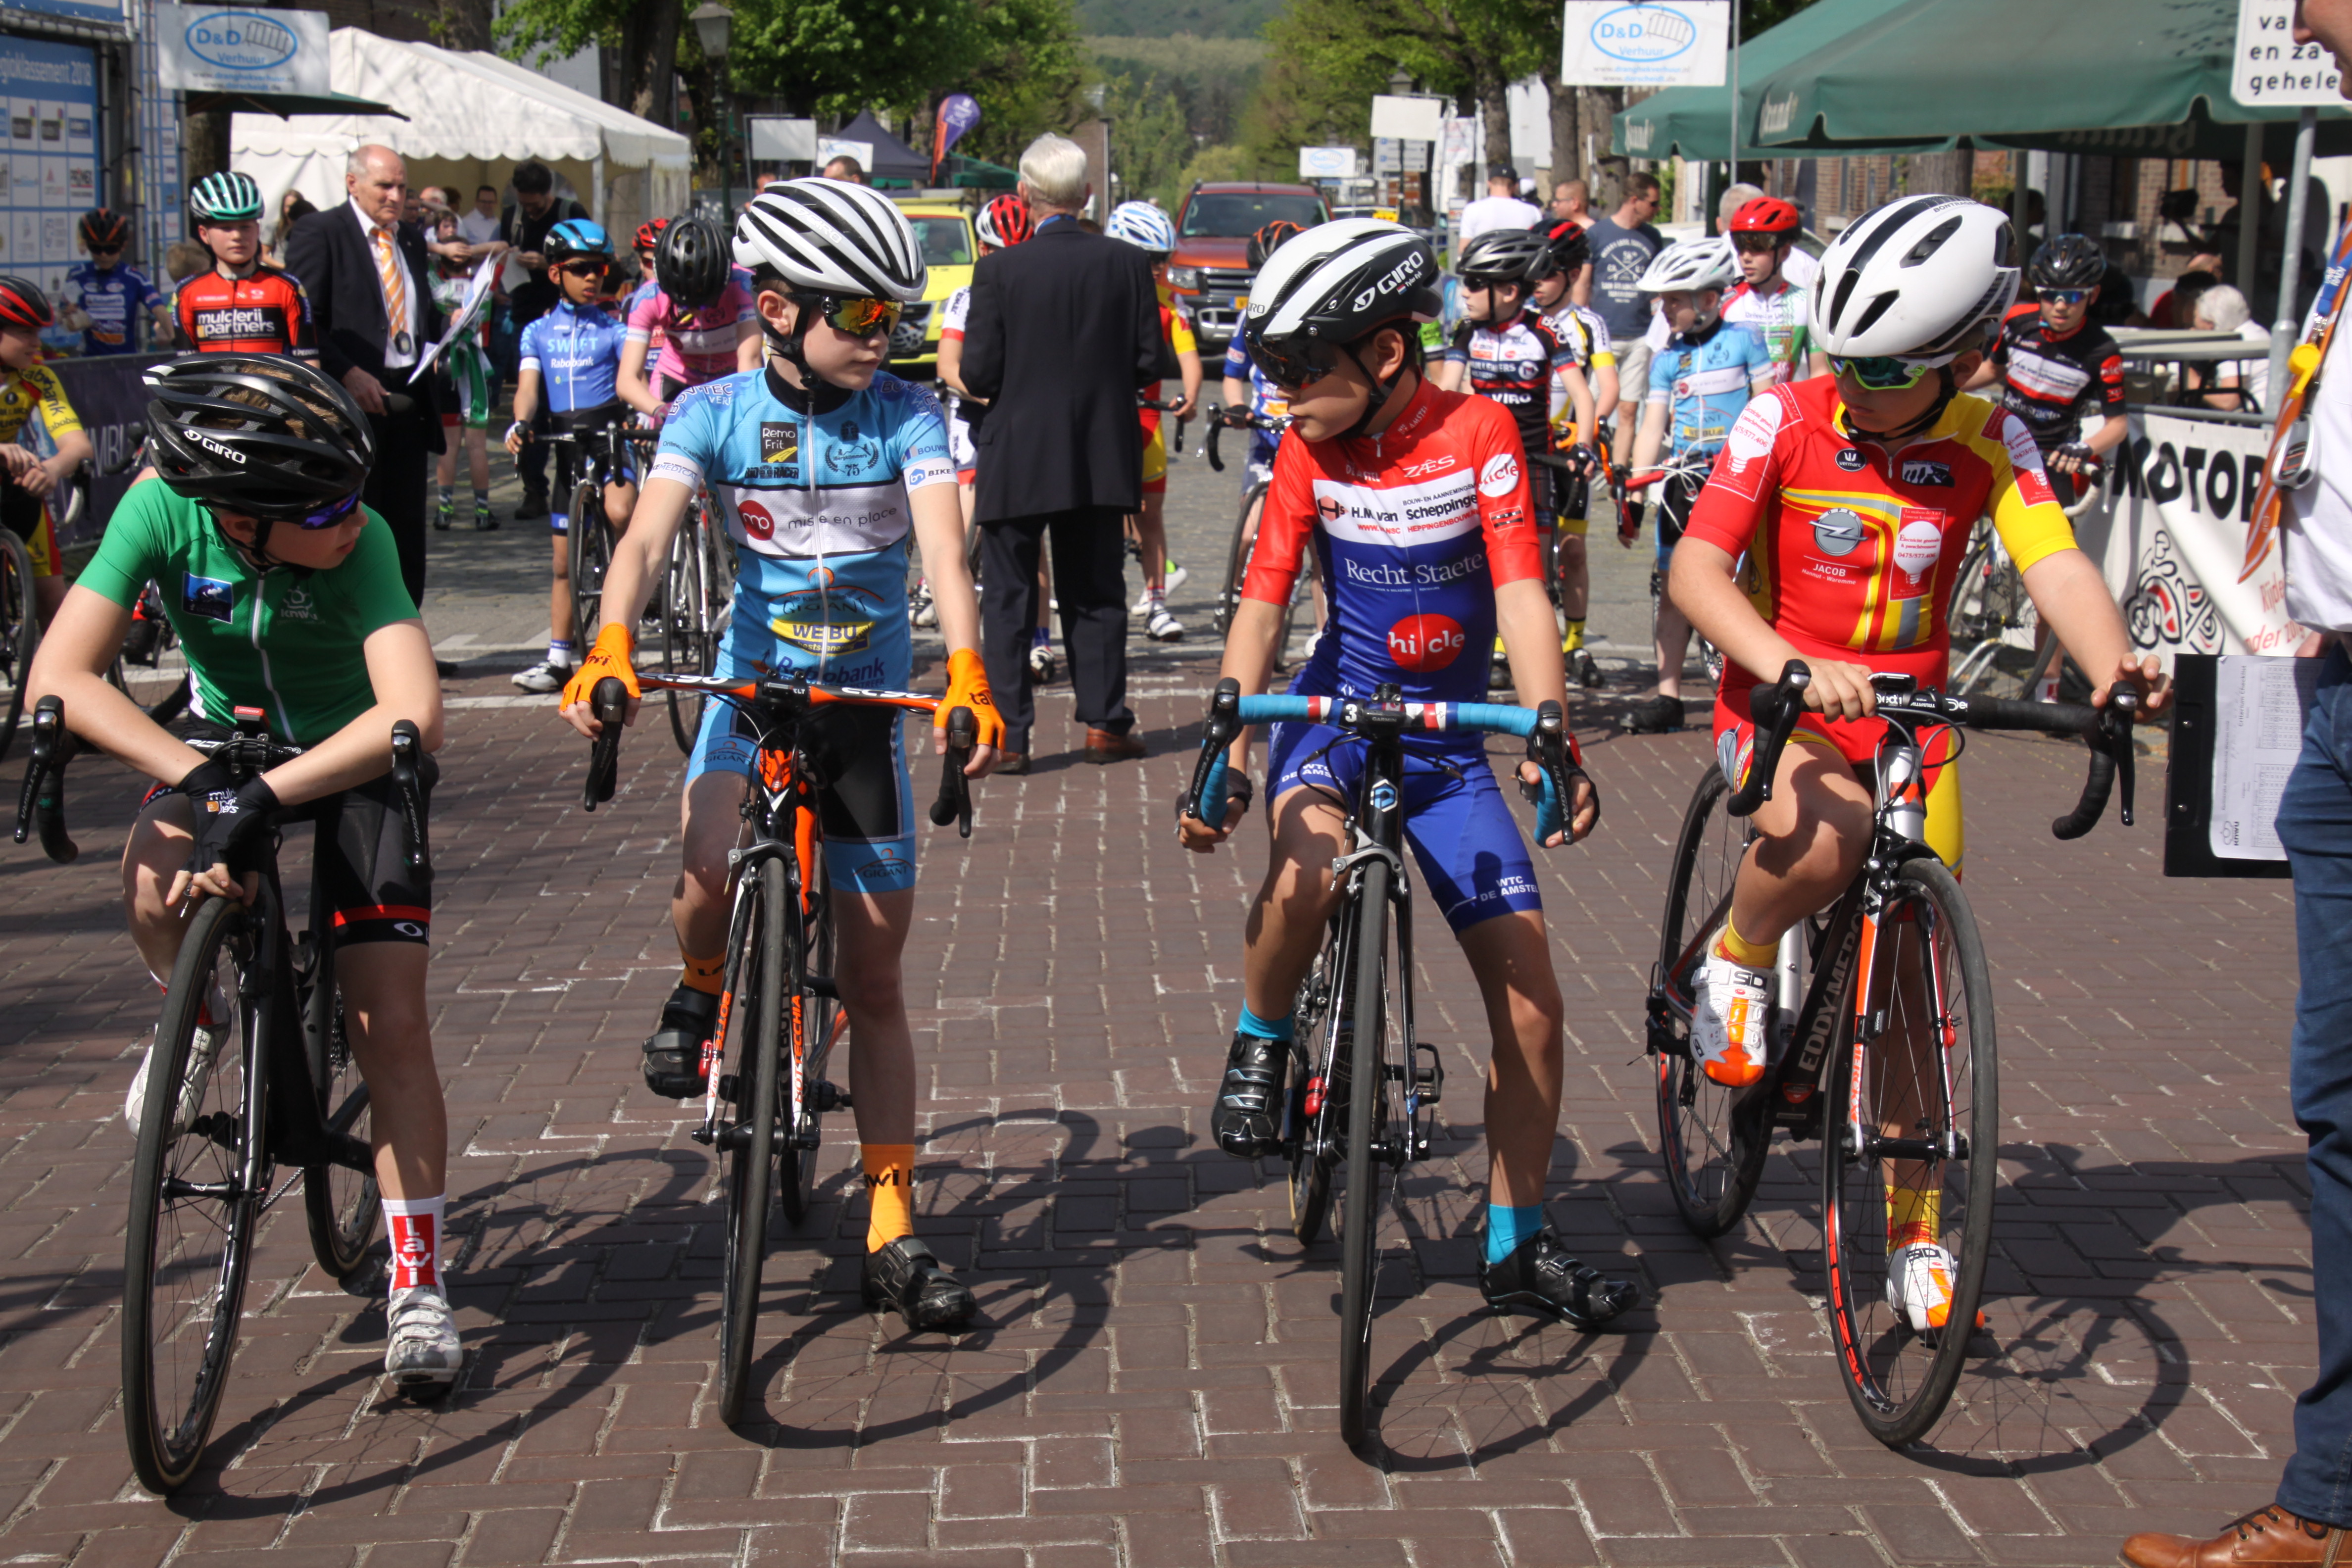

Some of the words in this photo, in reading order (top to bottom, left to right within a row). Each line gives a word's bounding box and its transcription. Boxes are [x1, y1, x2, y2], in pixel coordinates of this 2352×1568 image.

[196, 28, 241, 45] D&D
[1601, 23, 1642, 38] D&D
[216, 52, 266, 64] Verhuur
[1619, 46, 1664, 55] Verhuur
[2249, 71, 2338, 95] gehele
[1376, 251, 1424, 295] GIRO
[203, 321, 275, 338] partners
[1541, 315, 1568, 344] BDO
[547, 337, 598, 353] SWIFT
[550, 356, 594, 369] Rabobank
[1492, 393, 1532, 404] VIRO
[762, 428, 796, 439] Remo
[202, 437, 246, 464] GIRO
[765, 439, 785, 450] Frit
[845, 464, 860, 477] 75
[788, 515, 827, 530] mise
[833, 516, 852, 525] en
[858, 507, 897, 528] place
[1377, 511, 1399, 523] van
[1344, 557, 1411, 585] Recht
[1415, 553, 1484, 585] Staete
[1801, 568, 1822, 580] Hannut
[1826, 575, 1857, 586] Waremme
[1813, 563, 1847, 578] JACOB
[1345, 704, 1358, 723] 3
[1193, 741, 1217, 796] ULTEGRA
[1281, 772, 1298, 783] DE
[1552, 764, 1570, 823] ULTEGRA
[403, 787, 420, 844] ULTEGRA
[863, 865, 908, 879] GIGANT
[1496, 875, 1524, 887] WTC
[1479, 890, 1498, 901] DE
[1798, 994, 1837, 1072] EDDY
